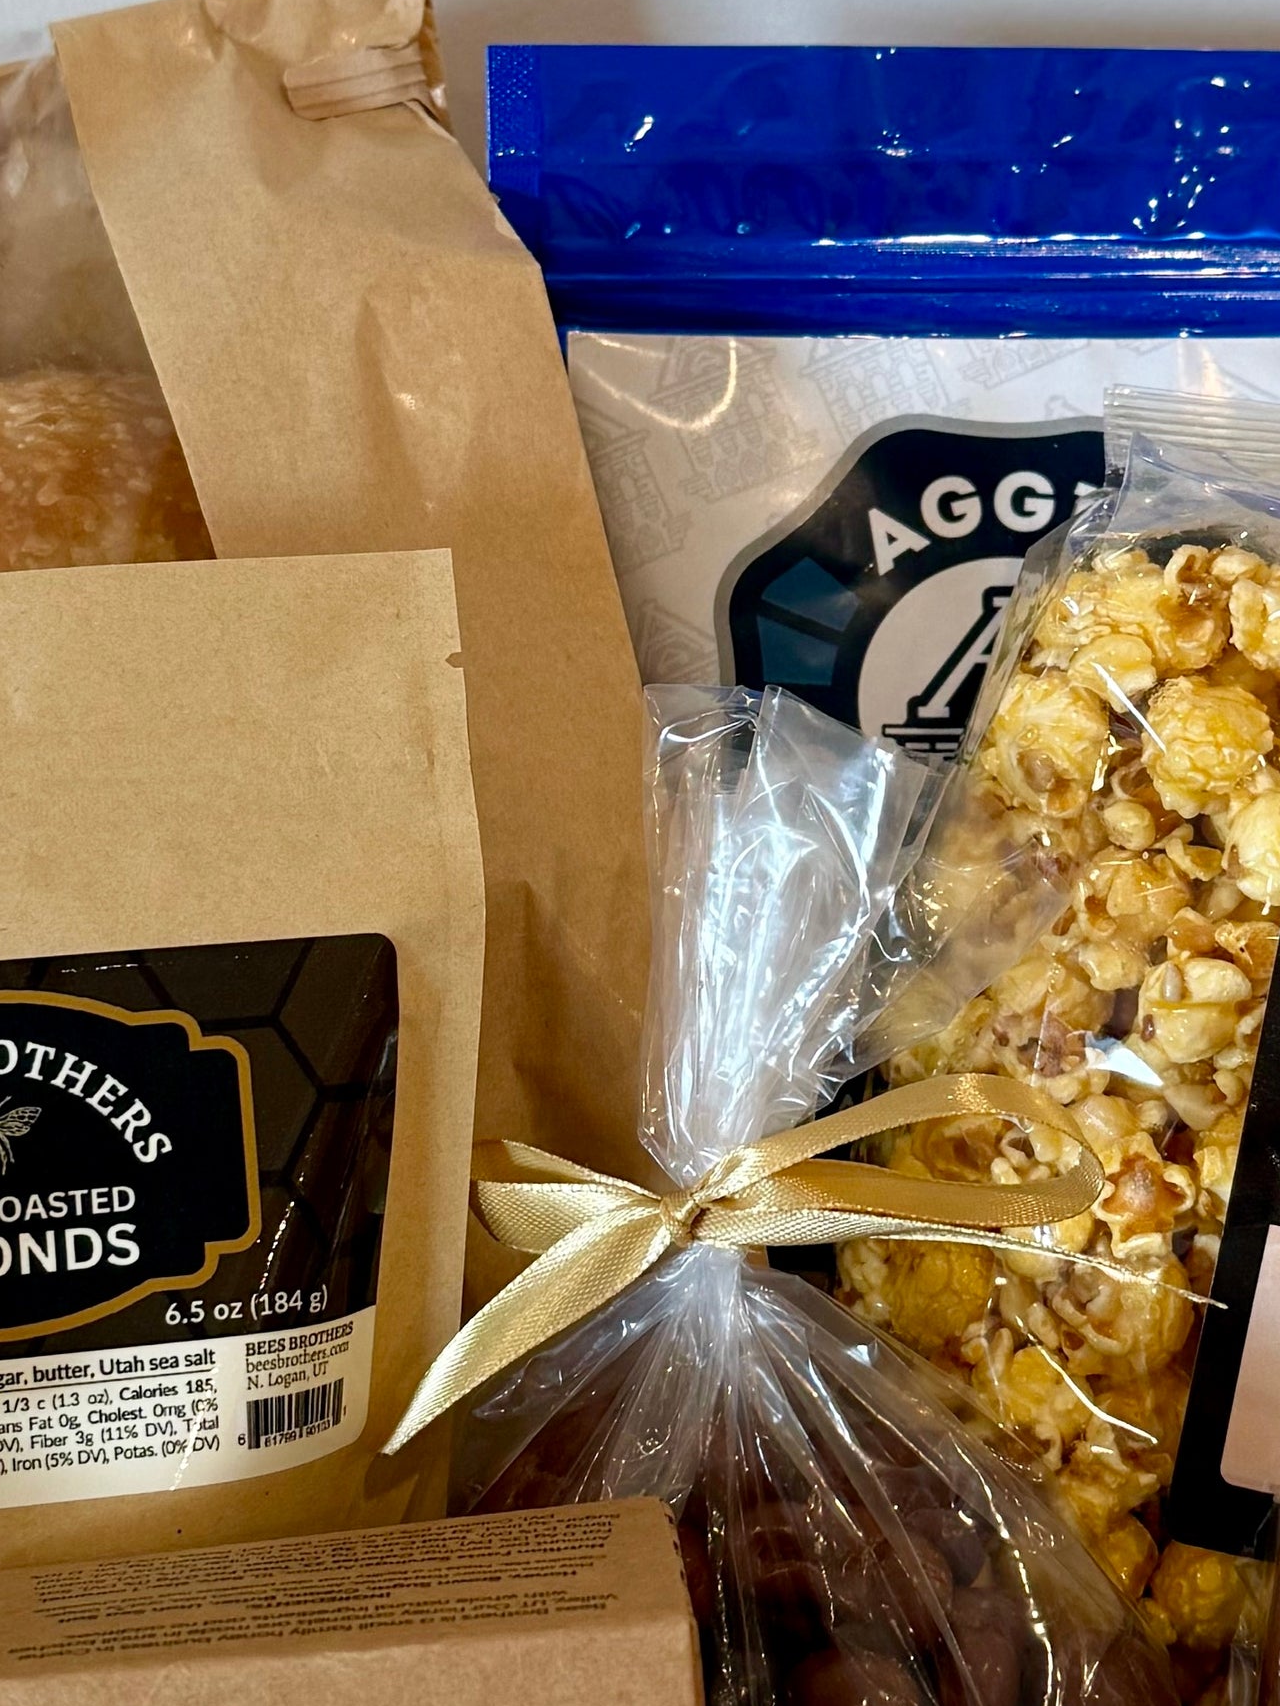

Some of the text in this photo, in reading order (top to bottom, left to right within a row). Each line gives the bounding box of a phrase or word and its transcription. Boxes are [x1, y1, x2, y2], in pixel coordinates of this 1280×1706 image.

[165, 1284, 328, 1325] 6.5 oz (184 g)
[245, 1321, 354, 1357] BEES BROTHERS
[32, 1360, 95, 1383] butter,
[98, 1354, 144, 1376] Utah
[148, 1355, 179, 1371] sea
[183, 1347, 216, 1368] salt
[246, 1341, 350, 1374] beesbrothers.com
[247, 1361, 329, 1391] N. Logan, UT
[2, 1396, 30, 1414] 1/3
[36, 1399, 46, 1410] c
[51, 1391, 80, 1410] (1.3
[118, 1381, 178, 1401] Calories
[28, 1415, 53, 1431] Fat
[152, 1401, 187, 1419] 0mg
[11, 1455, 42, 1472] Iron
[44, 1451, 74, 1470] (5%
[113, 1442, 158, 1460] Potas.
[191, 1434, 220, 1452] DV)
[29, 1432, 69, 1449] Fiber
[74, 1428, 94, 1447] 3g
[100, 1424, 139, 1444] (11%
